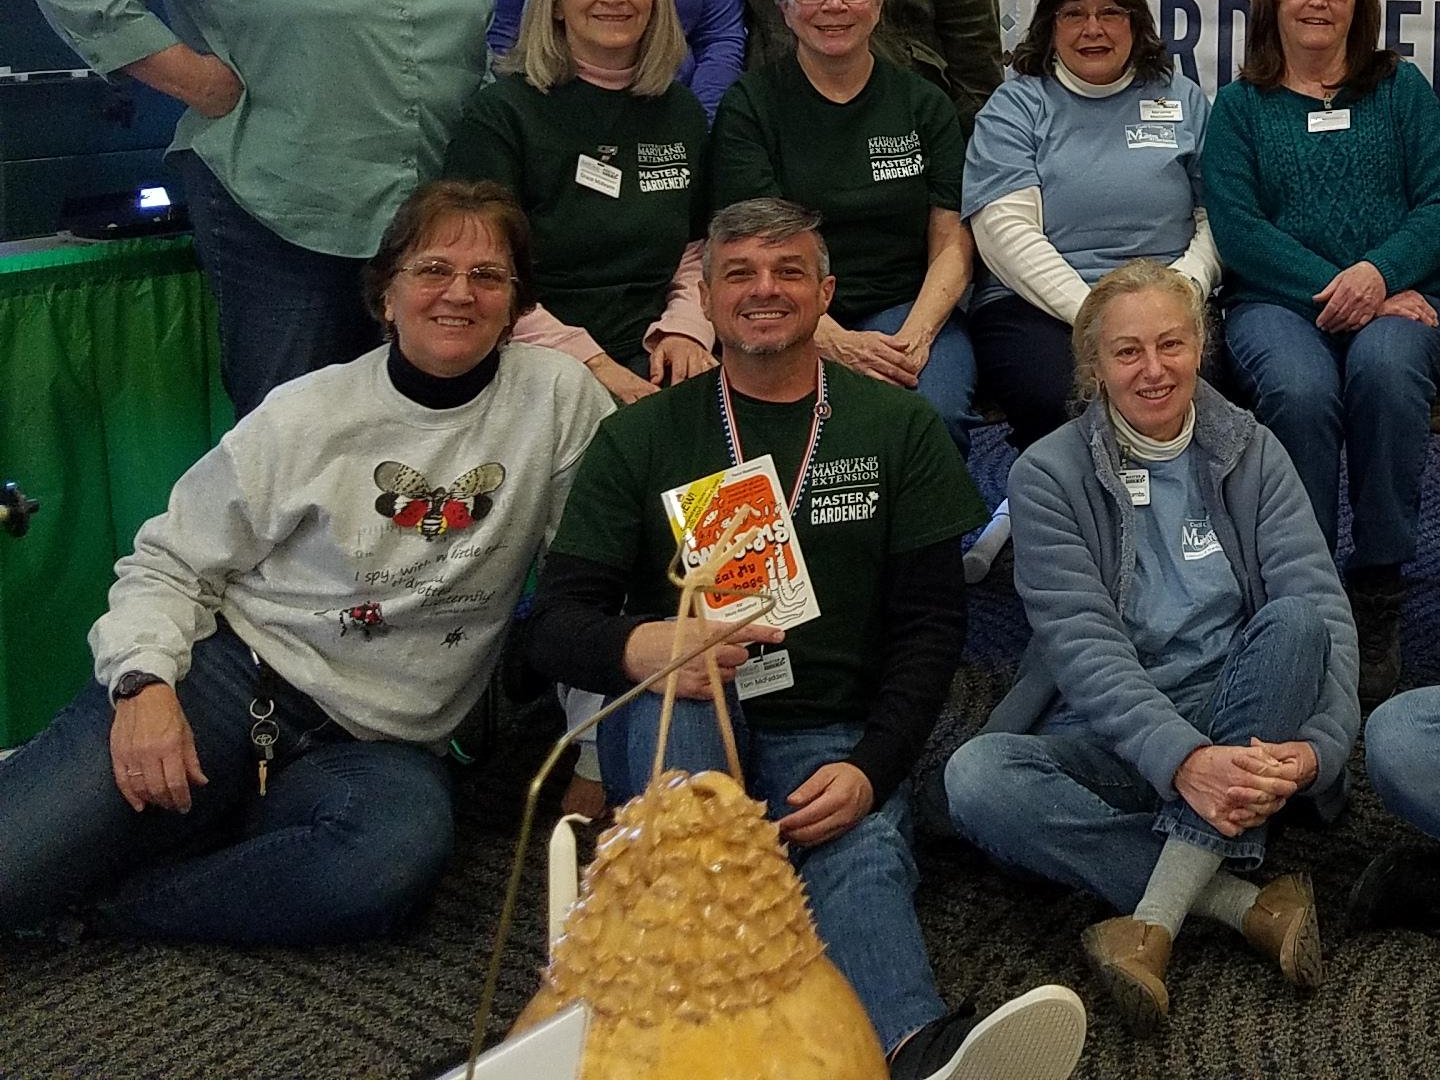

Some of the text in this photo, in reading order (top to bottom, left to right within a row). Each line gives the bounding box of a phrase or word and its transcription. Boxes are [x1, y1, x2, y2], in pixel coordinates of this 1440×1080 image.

[871, 158, 913, 170] MASTER
[639, 168, 679, 180] MASTER
[872, 163, 919, 182] GARDENER
[639, 177, 685, 193] GARDENER
[811, 462, 879, 478] MARYLAND
[811, 471, 879, 487] EXTENSION
[811, 492, 864, 509] MASTER
[810, 503, 869, 526] GARDENER
